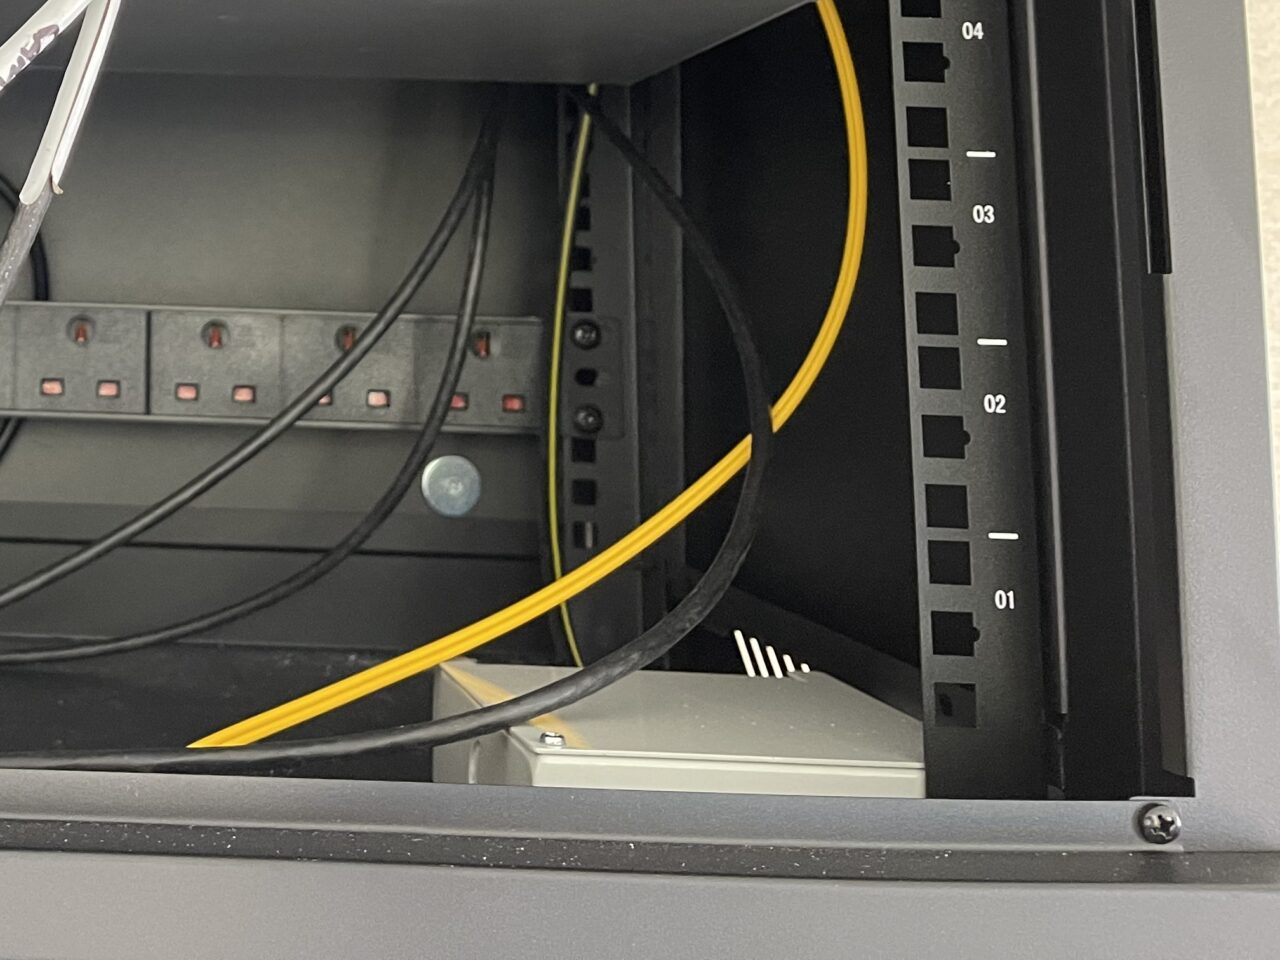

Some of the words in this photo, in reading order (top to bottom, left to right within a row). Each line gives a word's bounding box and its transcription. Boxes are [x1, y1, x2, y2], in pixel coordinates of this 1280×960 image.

[961, 21, 985, 40] 04
[972, 204, 996, 224] 03
[983, 393, 1007, 414] 02
[994, 589, 1015, 610] 01
